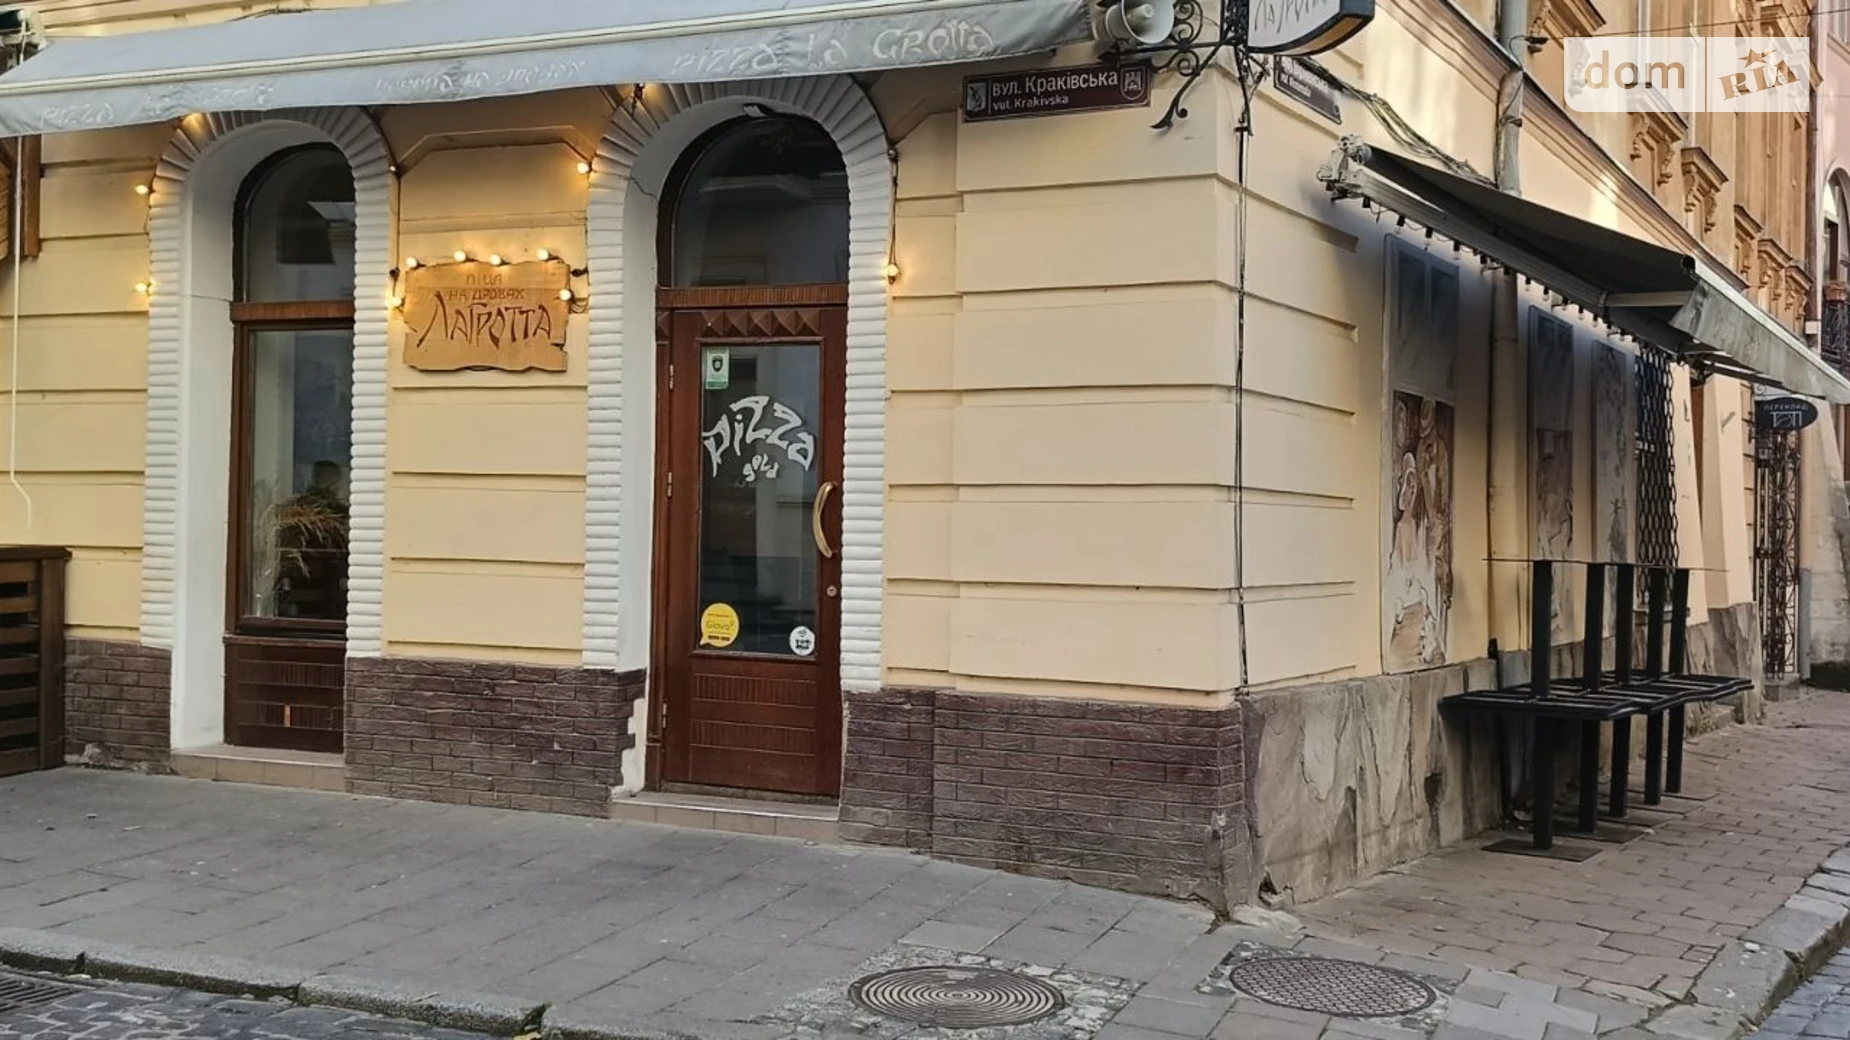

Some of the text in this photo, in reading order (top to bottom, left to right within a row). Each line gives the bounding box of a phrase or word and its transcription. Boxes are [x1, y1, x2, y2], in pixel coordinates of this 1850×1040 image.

[992, 71, 1119, 97] вул. Краківська
[1015, 95, 1069, 110] Krakivska
[449, 288, 526, 301] НА ДРОВАХ
